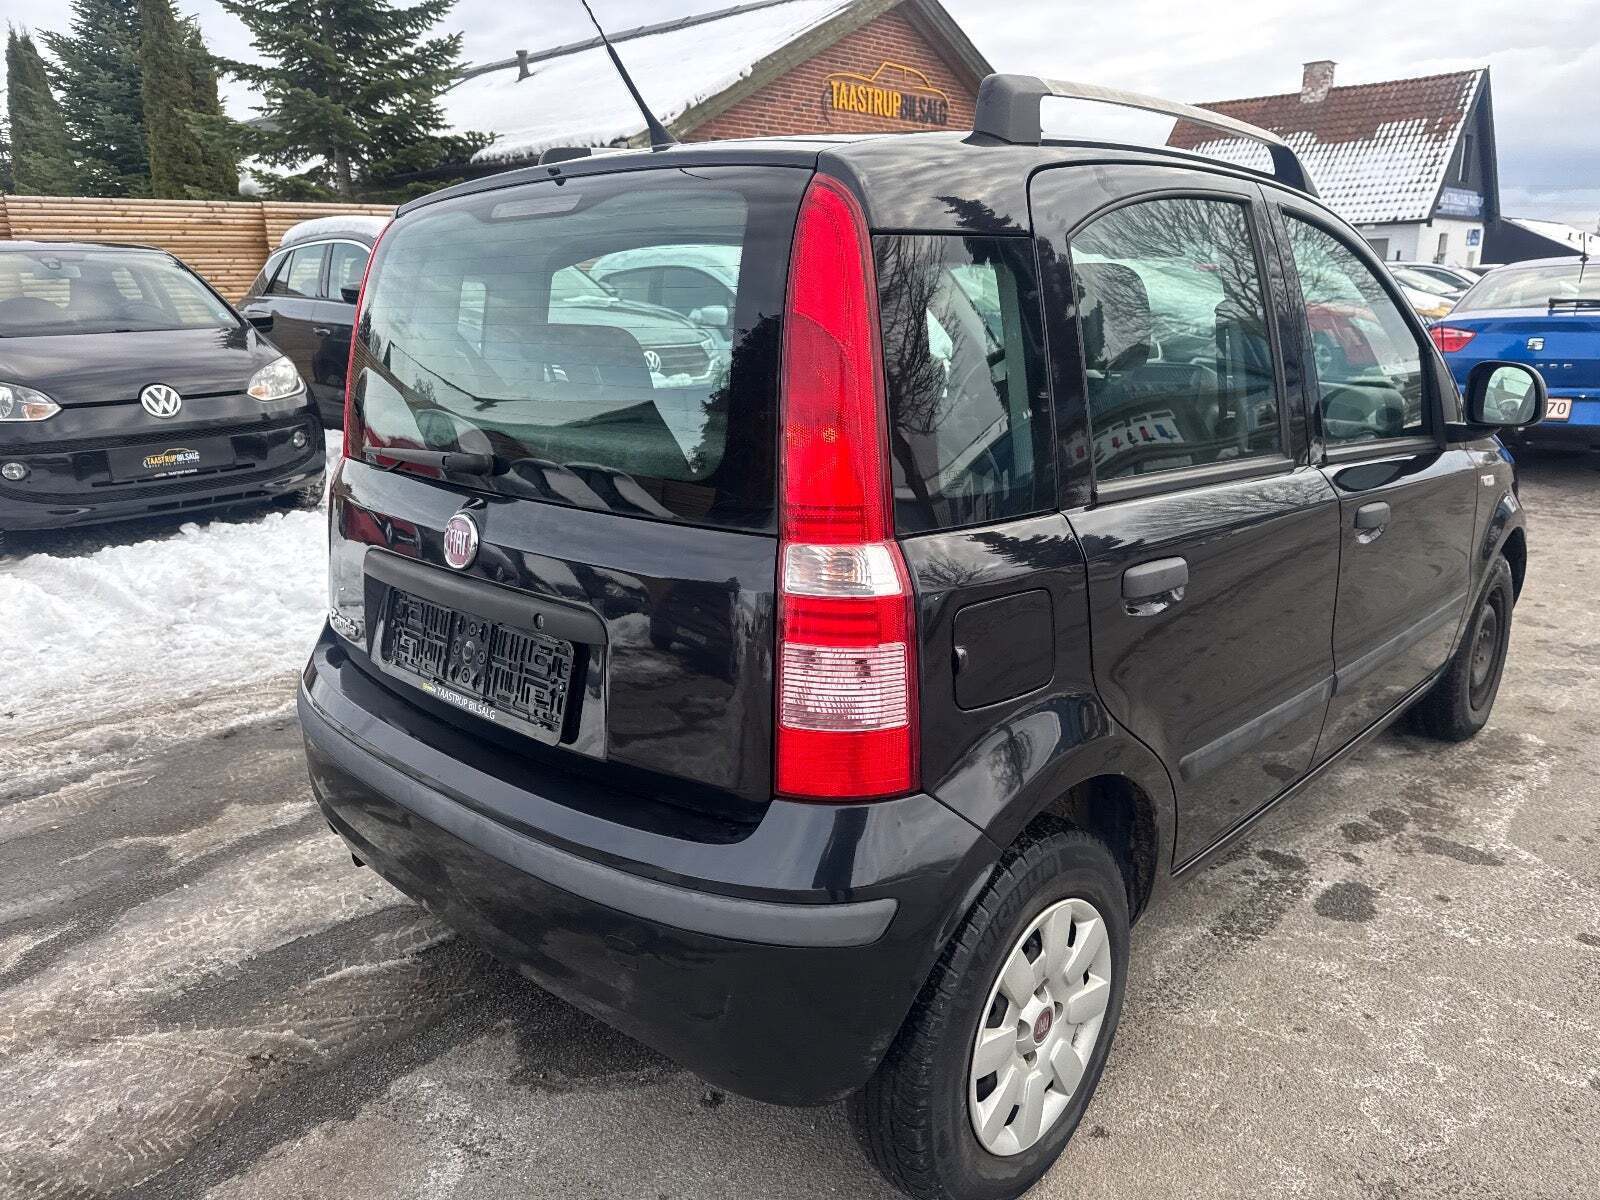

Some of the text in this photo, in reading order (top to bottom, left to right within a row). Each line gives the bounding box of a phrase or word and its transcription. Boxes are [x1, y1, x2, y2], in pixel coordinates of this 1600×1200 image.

[449, 529, 469, 555] FIAT
[437, 687, 468, 706] TAASTRUP
[468, 701, 496, 720] BILSALG
